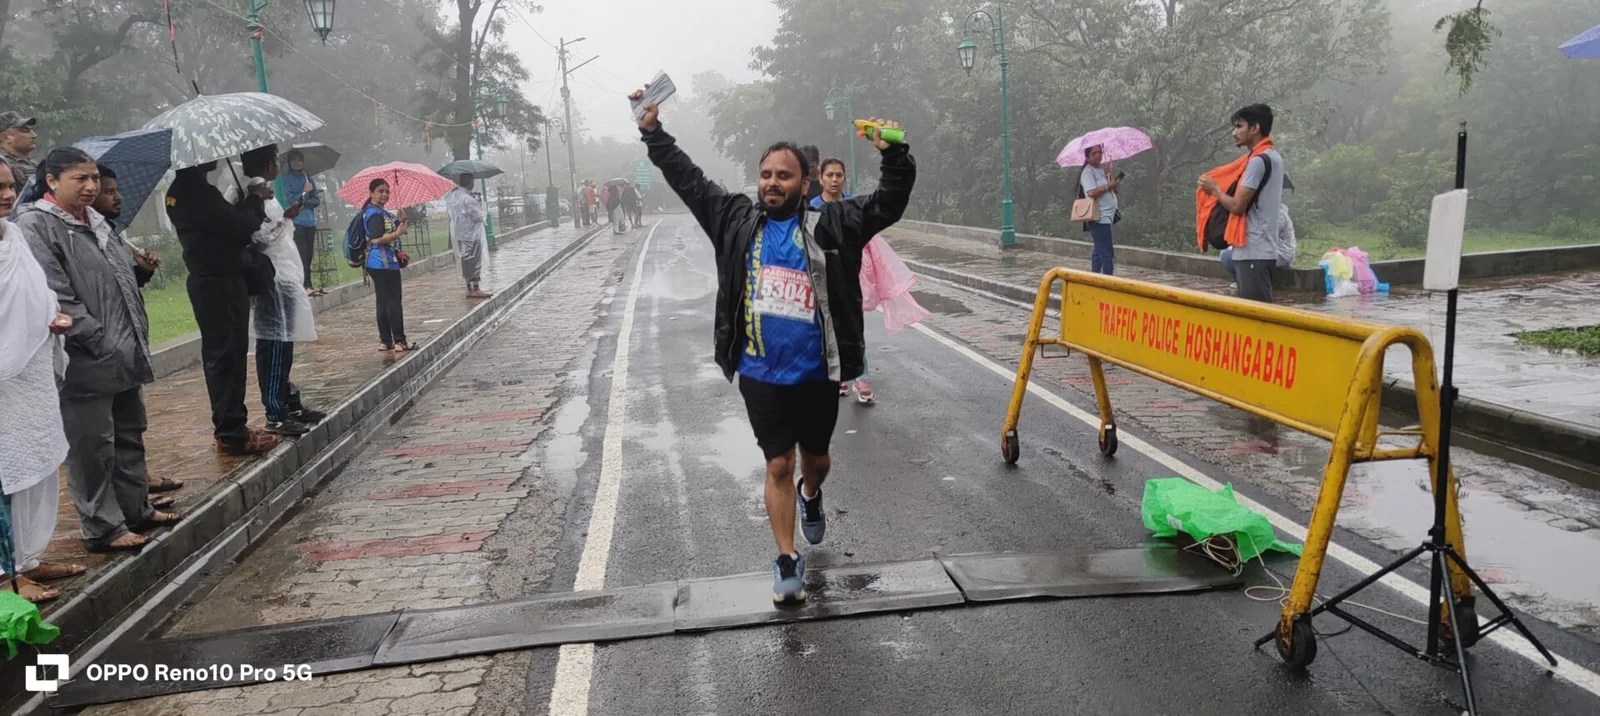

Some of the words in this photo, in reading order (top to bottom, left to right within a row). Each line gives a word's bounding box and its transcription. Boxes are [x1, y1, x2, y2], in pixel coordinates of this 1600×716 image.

[1099, 301, 1138, 343] TRAFFIC
[1142, 311, 1181, 356] POLICE
[1184, 322, 1297, 390] HOSHANGABAD
